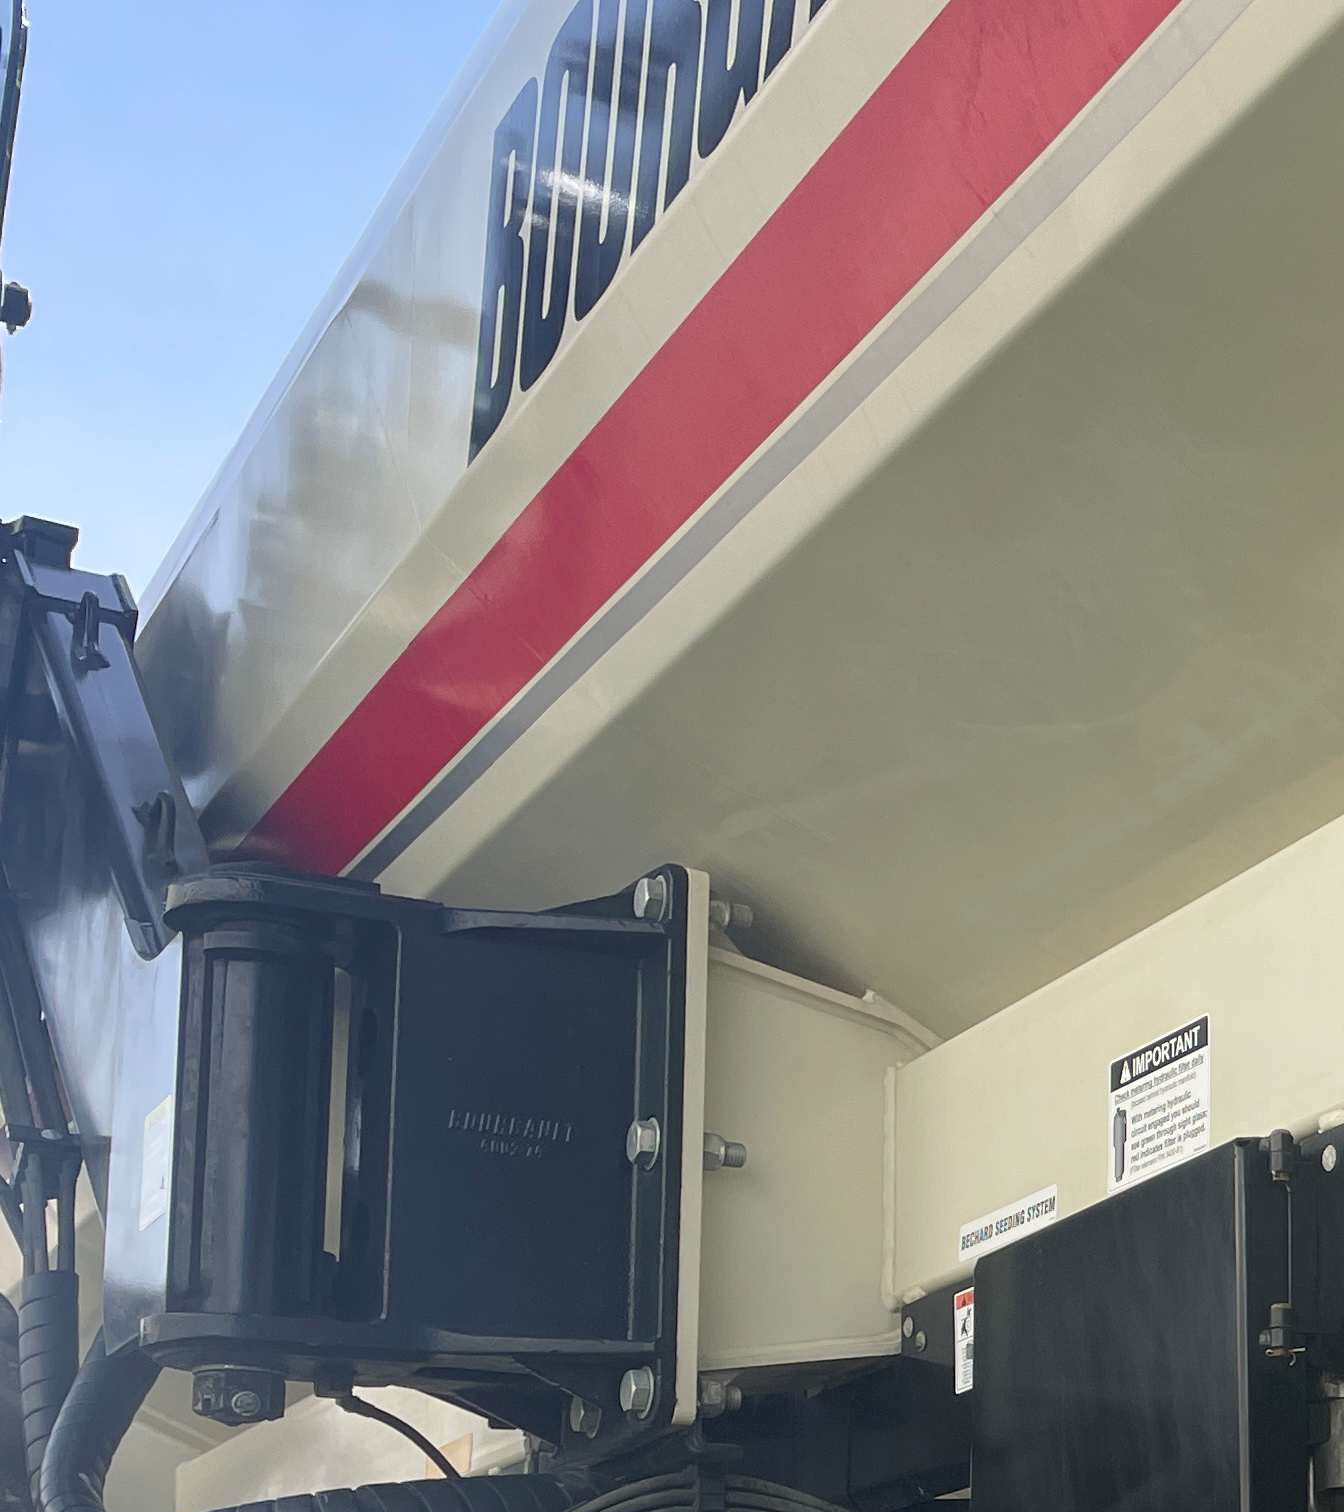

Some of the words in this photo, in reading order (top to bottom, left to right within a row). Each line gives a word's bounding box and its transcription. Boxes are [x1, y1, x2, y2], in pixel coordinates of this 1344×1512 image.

[1132, 1026, 1201, 1078] IMPORTANT
[995, 1210, 1025, 1235] SEEDING
[1027, 1196, 1055, 1222] SYSTEM
